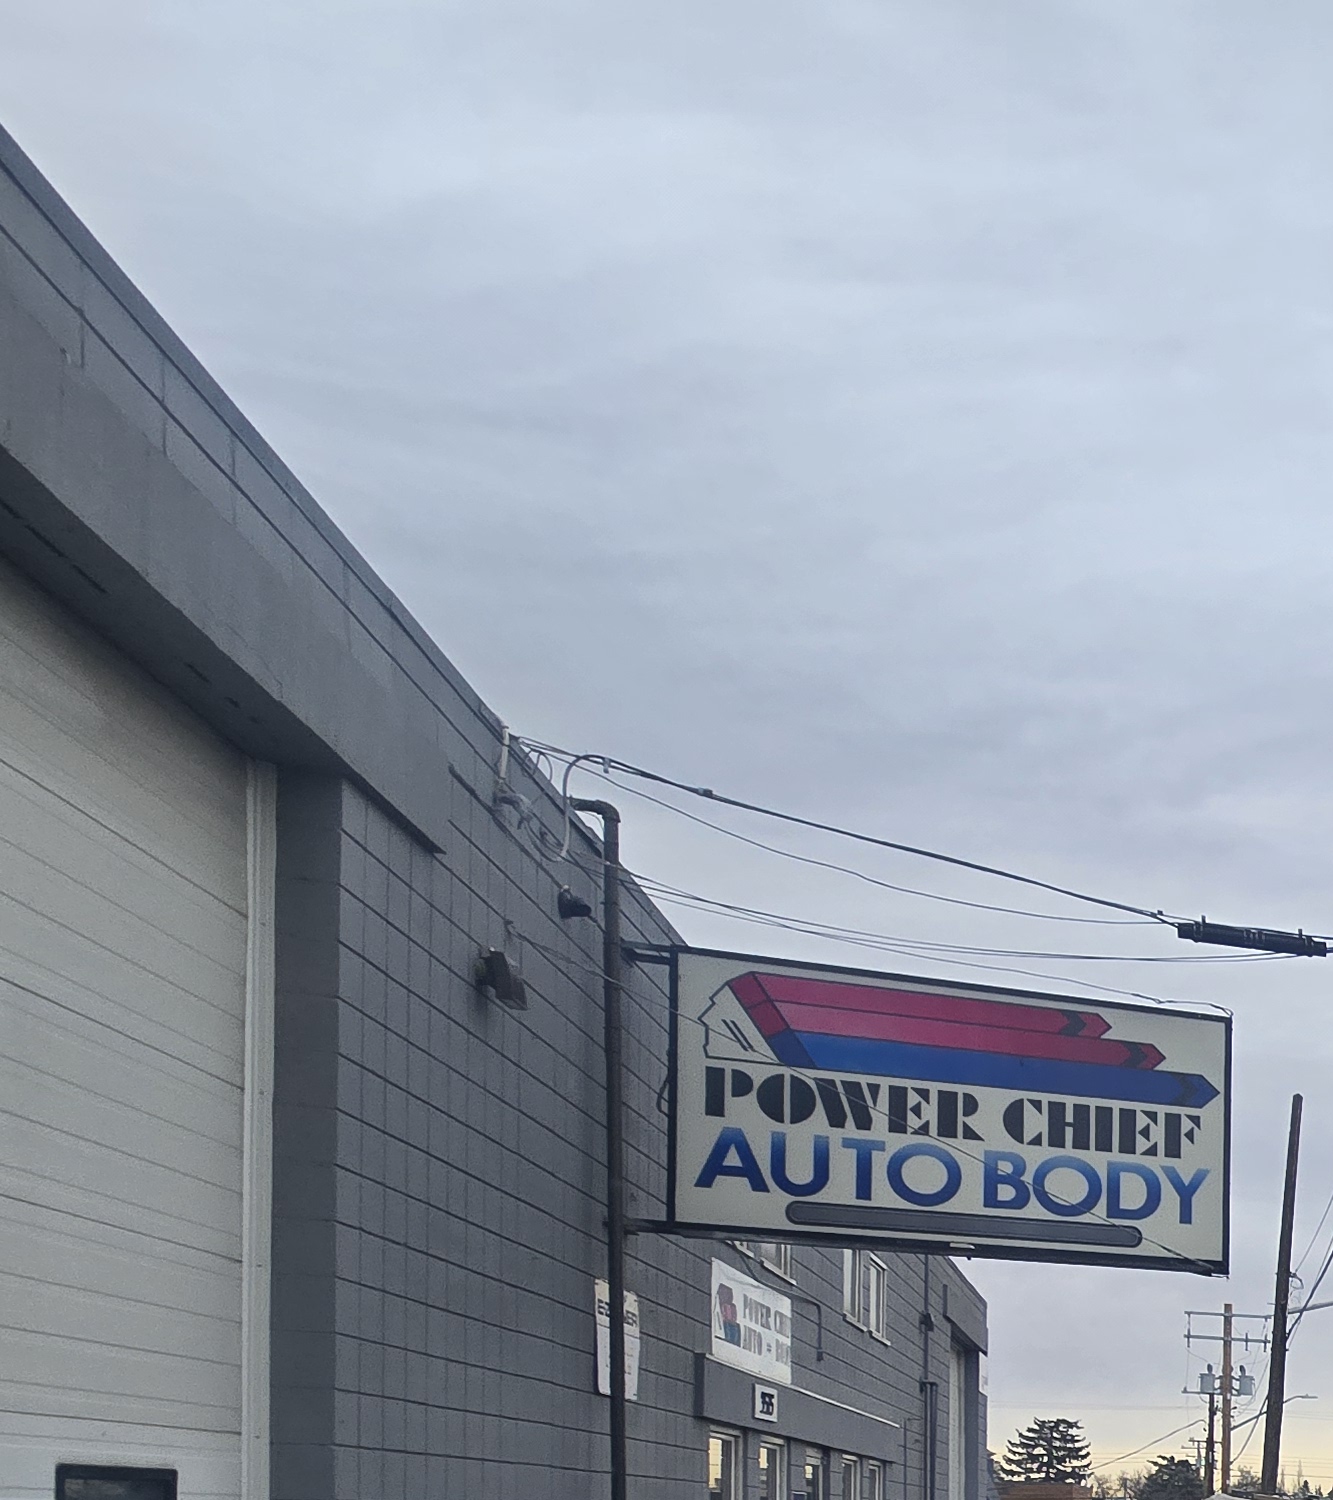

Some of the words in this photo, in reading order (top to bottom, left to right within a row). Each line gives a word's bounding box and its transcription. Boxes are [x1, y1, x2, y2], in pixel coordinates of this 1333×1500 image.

[704, 1065, 985, 1142] POWER
[1003, 1098, 1202, 1159] CHIEF
[694, 1127, 962, 1207] AUTO
[983, 1149, 1212, 1225] BODY
